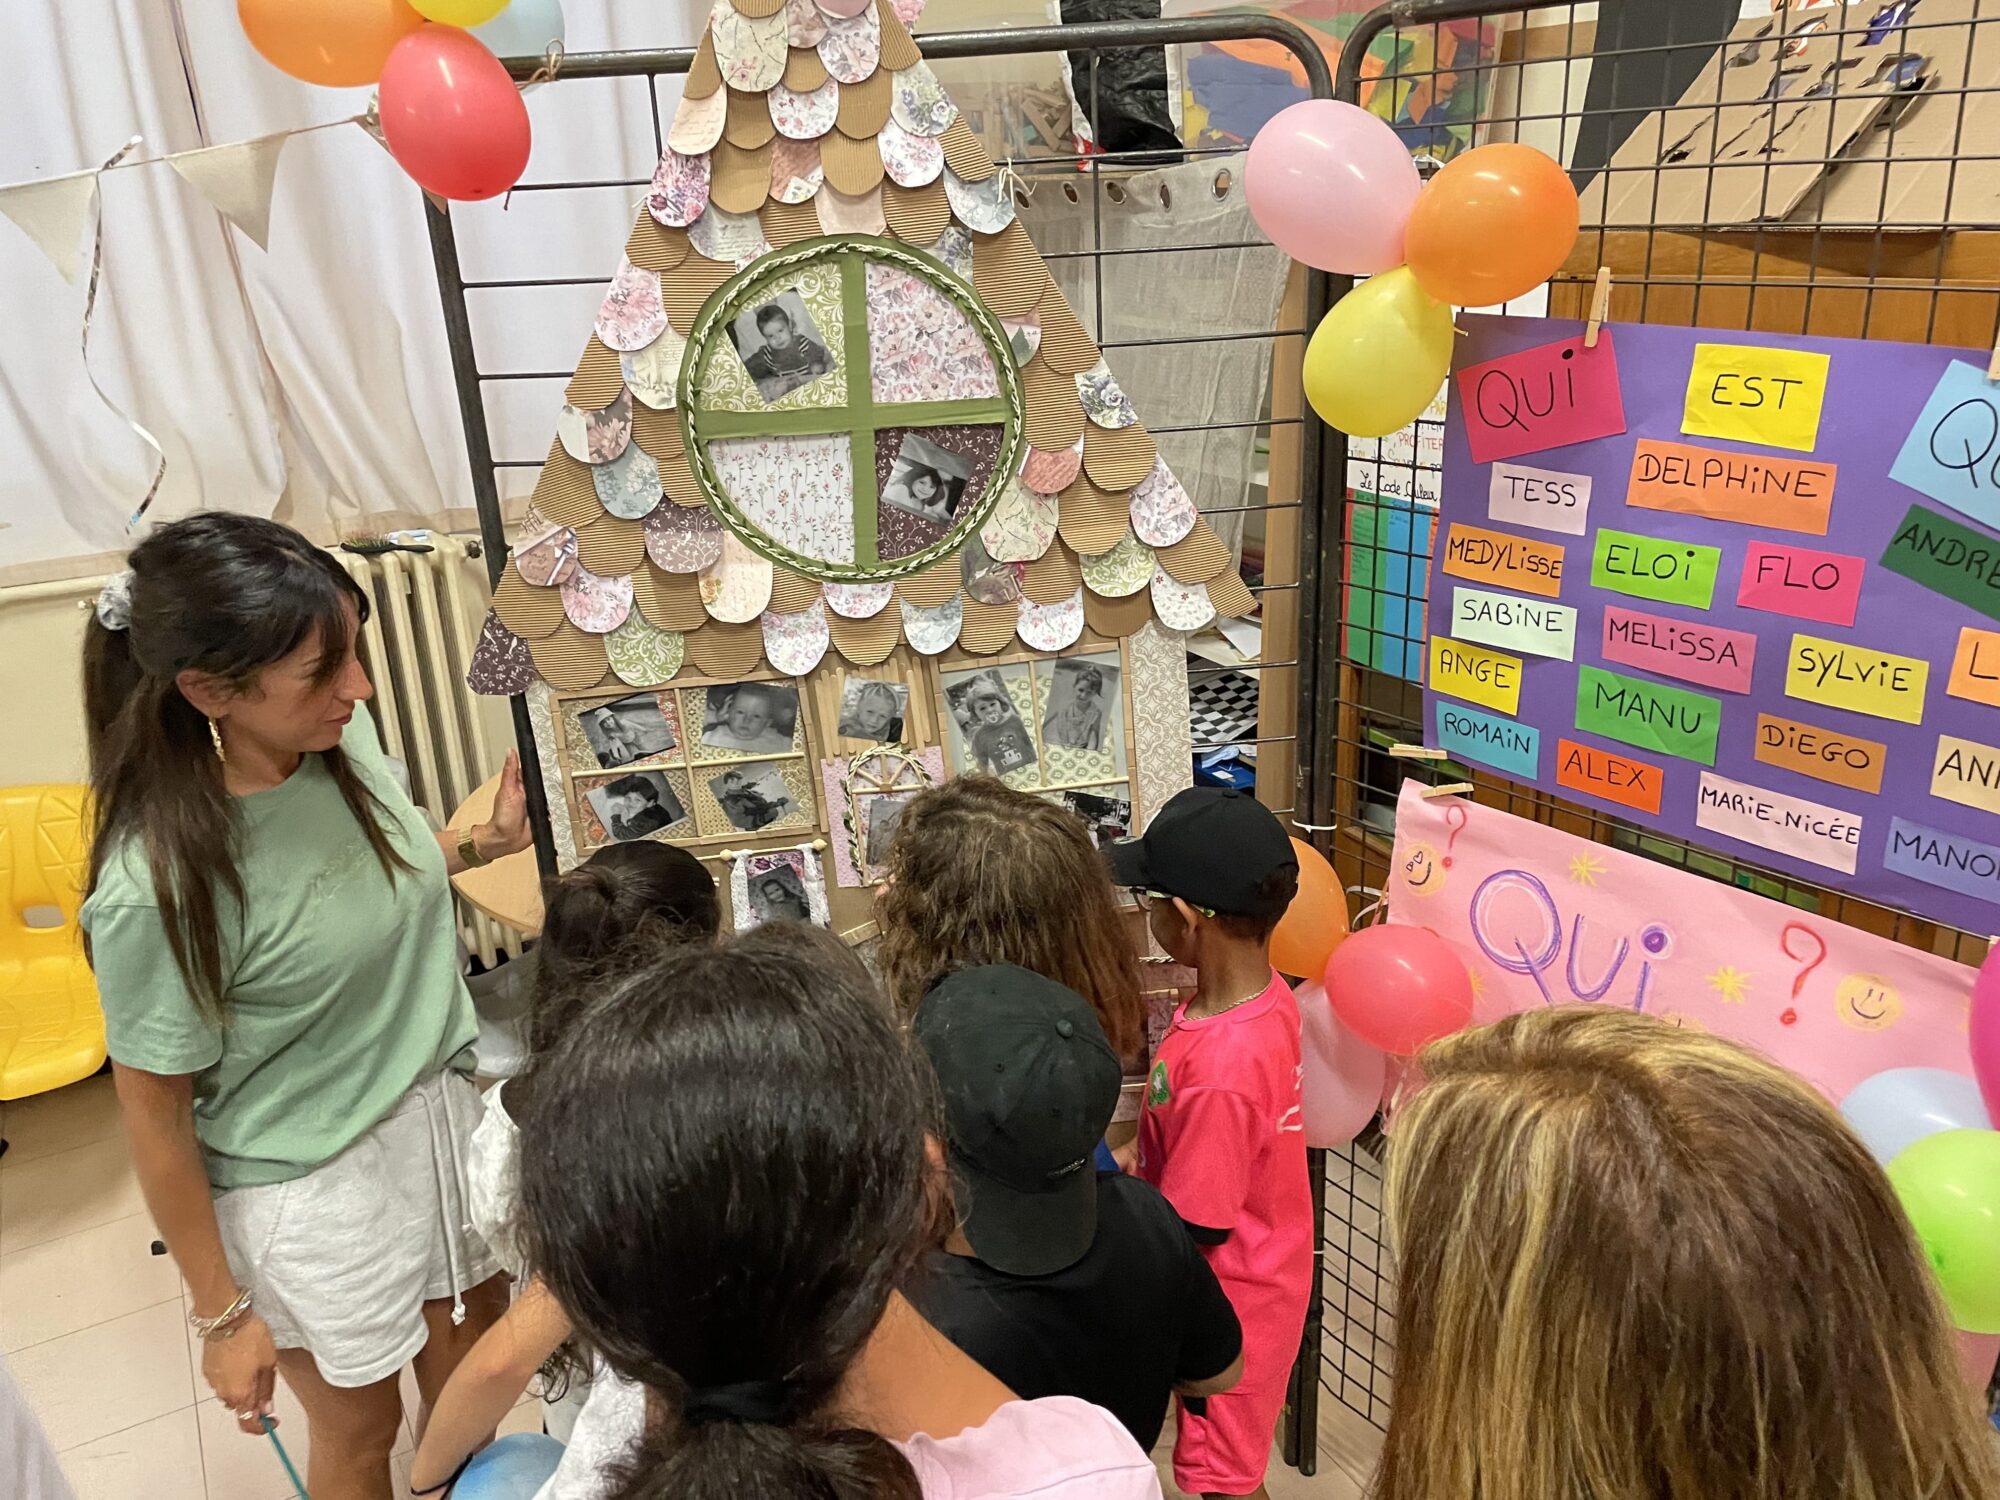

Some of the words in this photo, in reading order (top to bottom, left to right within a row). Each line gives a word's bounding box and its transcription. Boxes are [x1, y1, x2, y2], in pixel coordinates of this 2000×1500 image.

[1712, 373, 1803, 409] EST
[1360, 469, 1373, 490] Le
[1503, 475, 1576, 507] TESS
[1757, 556, 1839, 590] FLO
[1440, 649, 1516, 688] ANGE
[1596, 682, 1701, 734] MANU
[1564, 749, 1646, 791] ALEX
[1893, 830, 2000, 881] MANO
